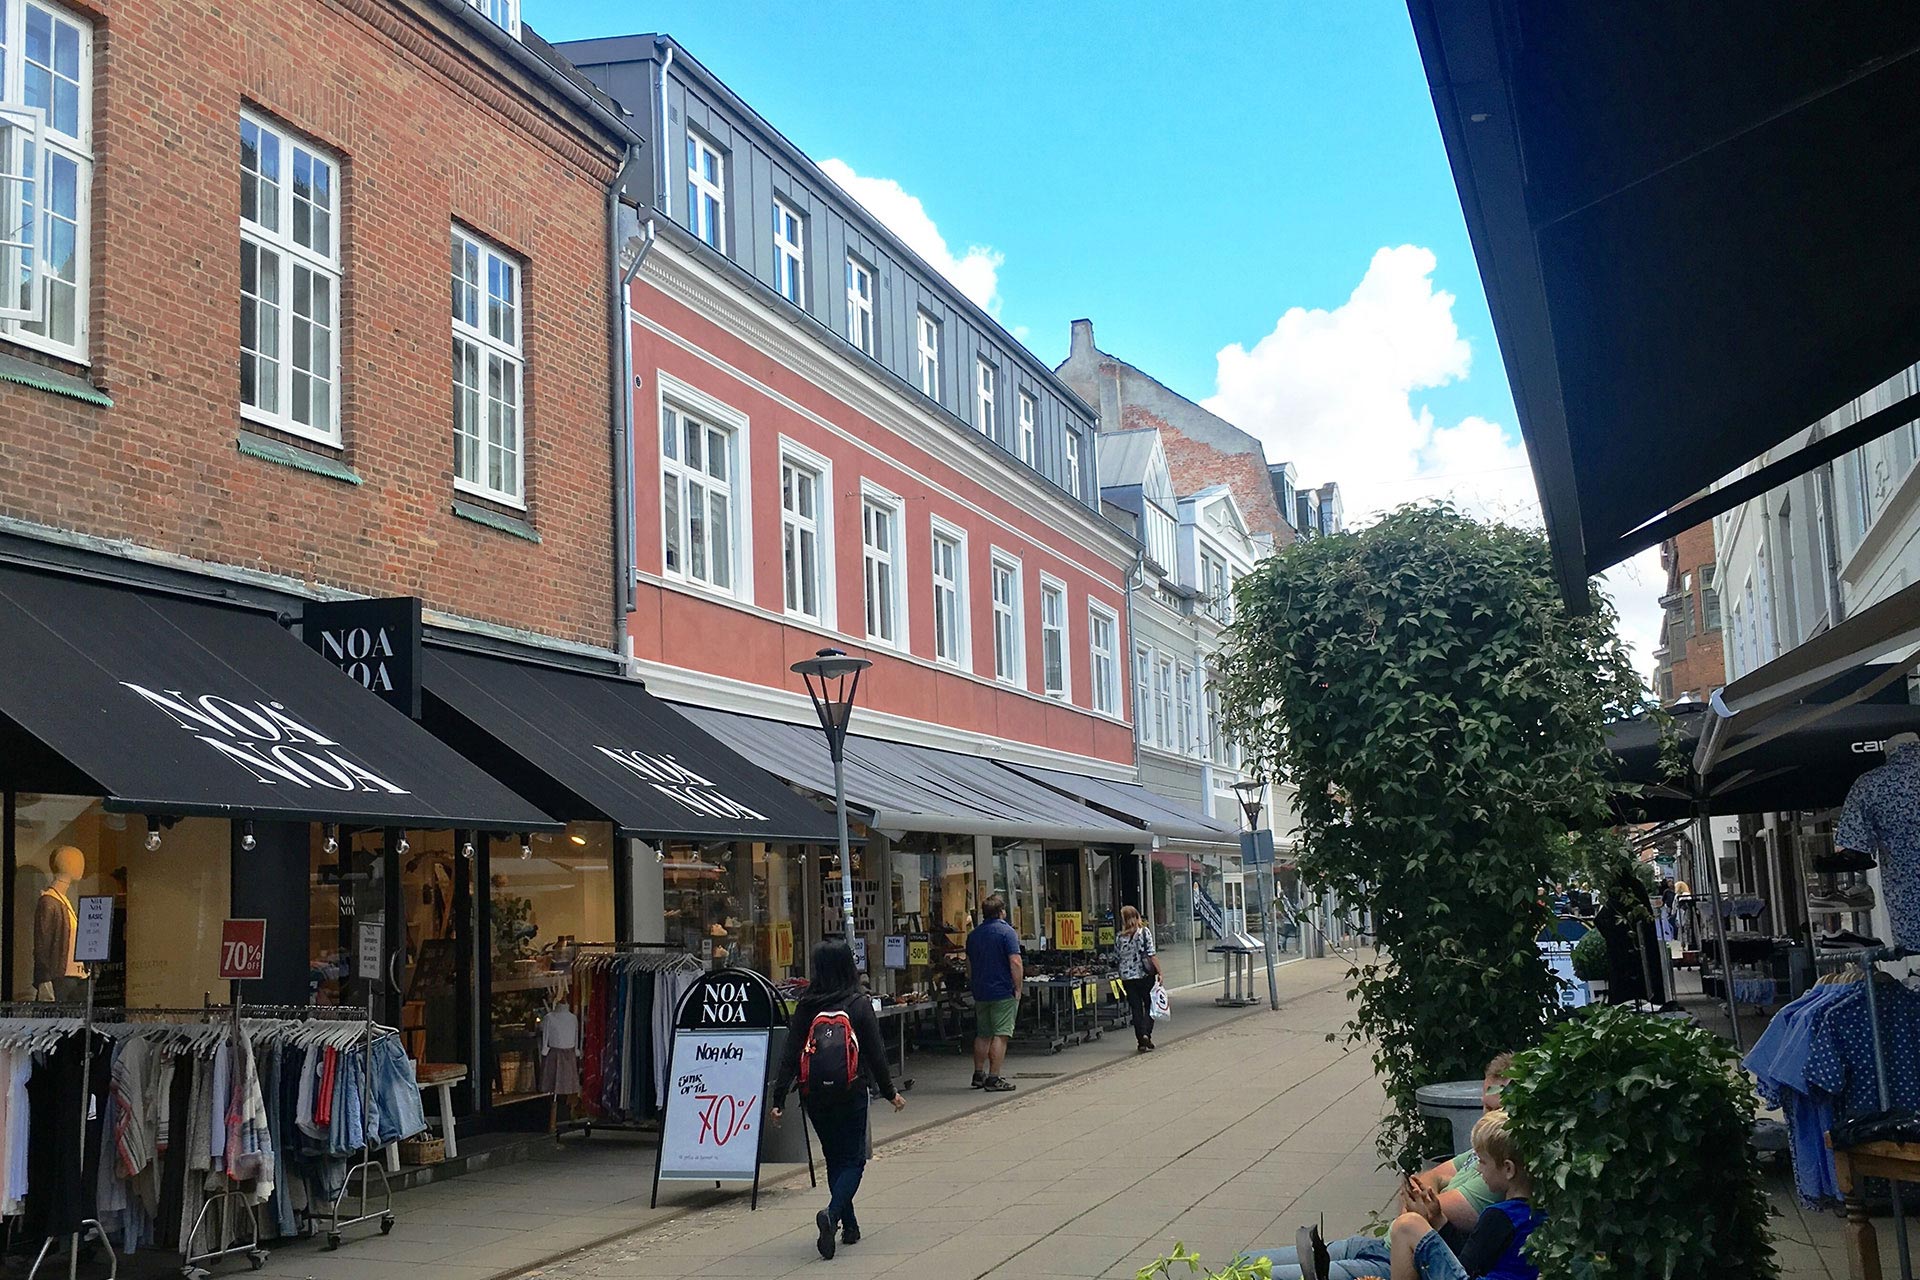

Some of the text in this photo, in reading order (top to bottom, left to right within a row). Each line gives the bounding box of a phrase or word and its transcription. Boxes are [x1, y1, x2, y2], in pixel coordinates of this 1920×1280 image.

[321, 627, 393, 659] NOA
[340, 662, 393, 691] OA
[119, 681, 340, 746] NOA
[194, 735, 411, 794] NOA
[593, 745, 717, 786] NOA
[648, 782, 770, 820] NOA
[340, 896, 355, 905] NOA
[340, 906, 355, 915] NOA
[224, 941, 261, 971] 70%
[247, 962, 260, 970] OFF
[910, 948, 928, 960] -50%
[703, 983, 750, 1002] NOA
[701, 1003, 747, 1023] NOA
[695, 1095, 756, 1146] 70%
